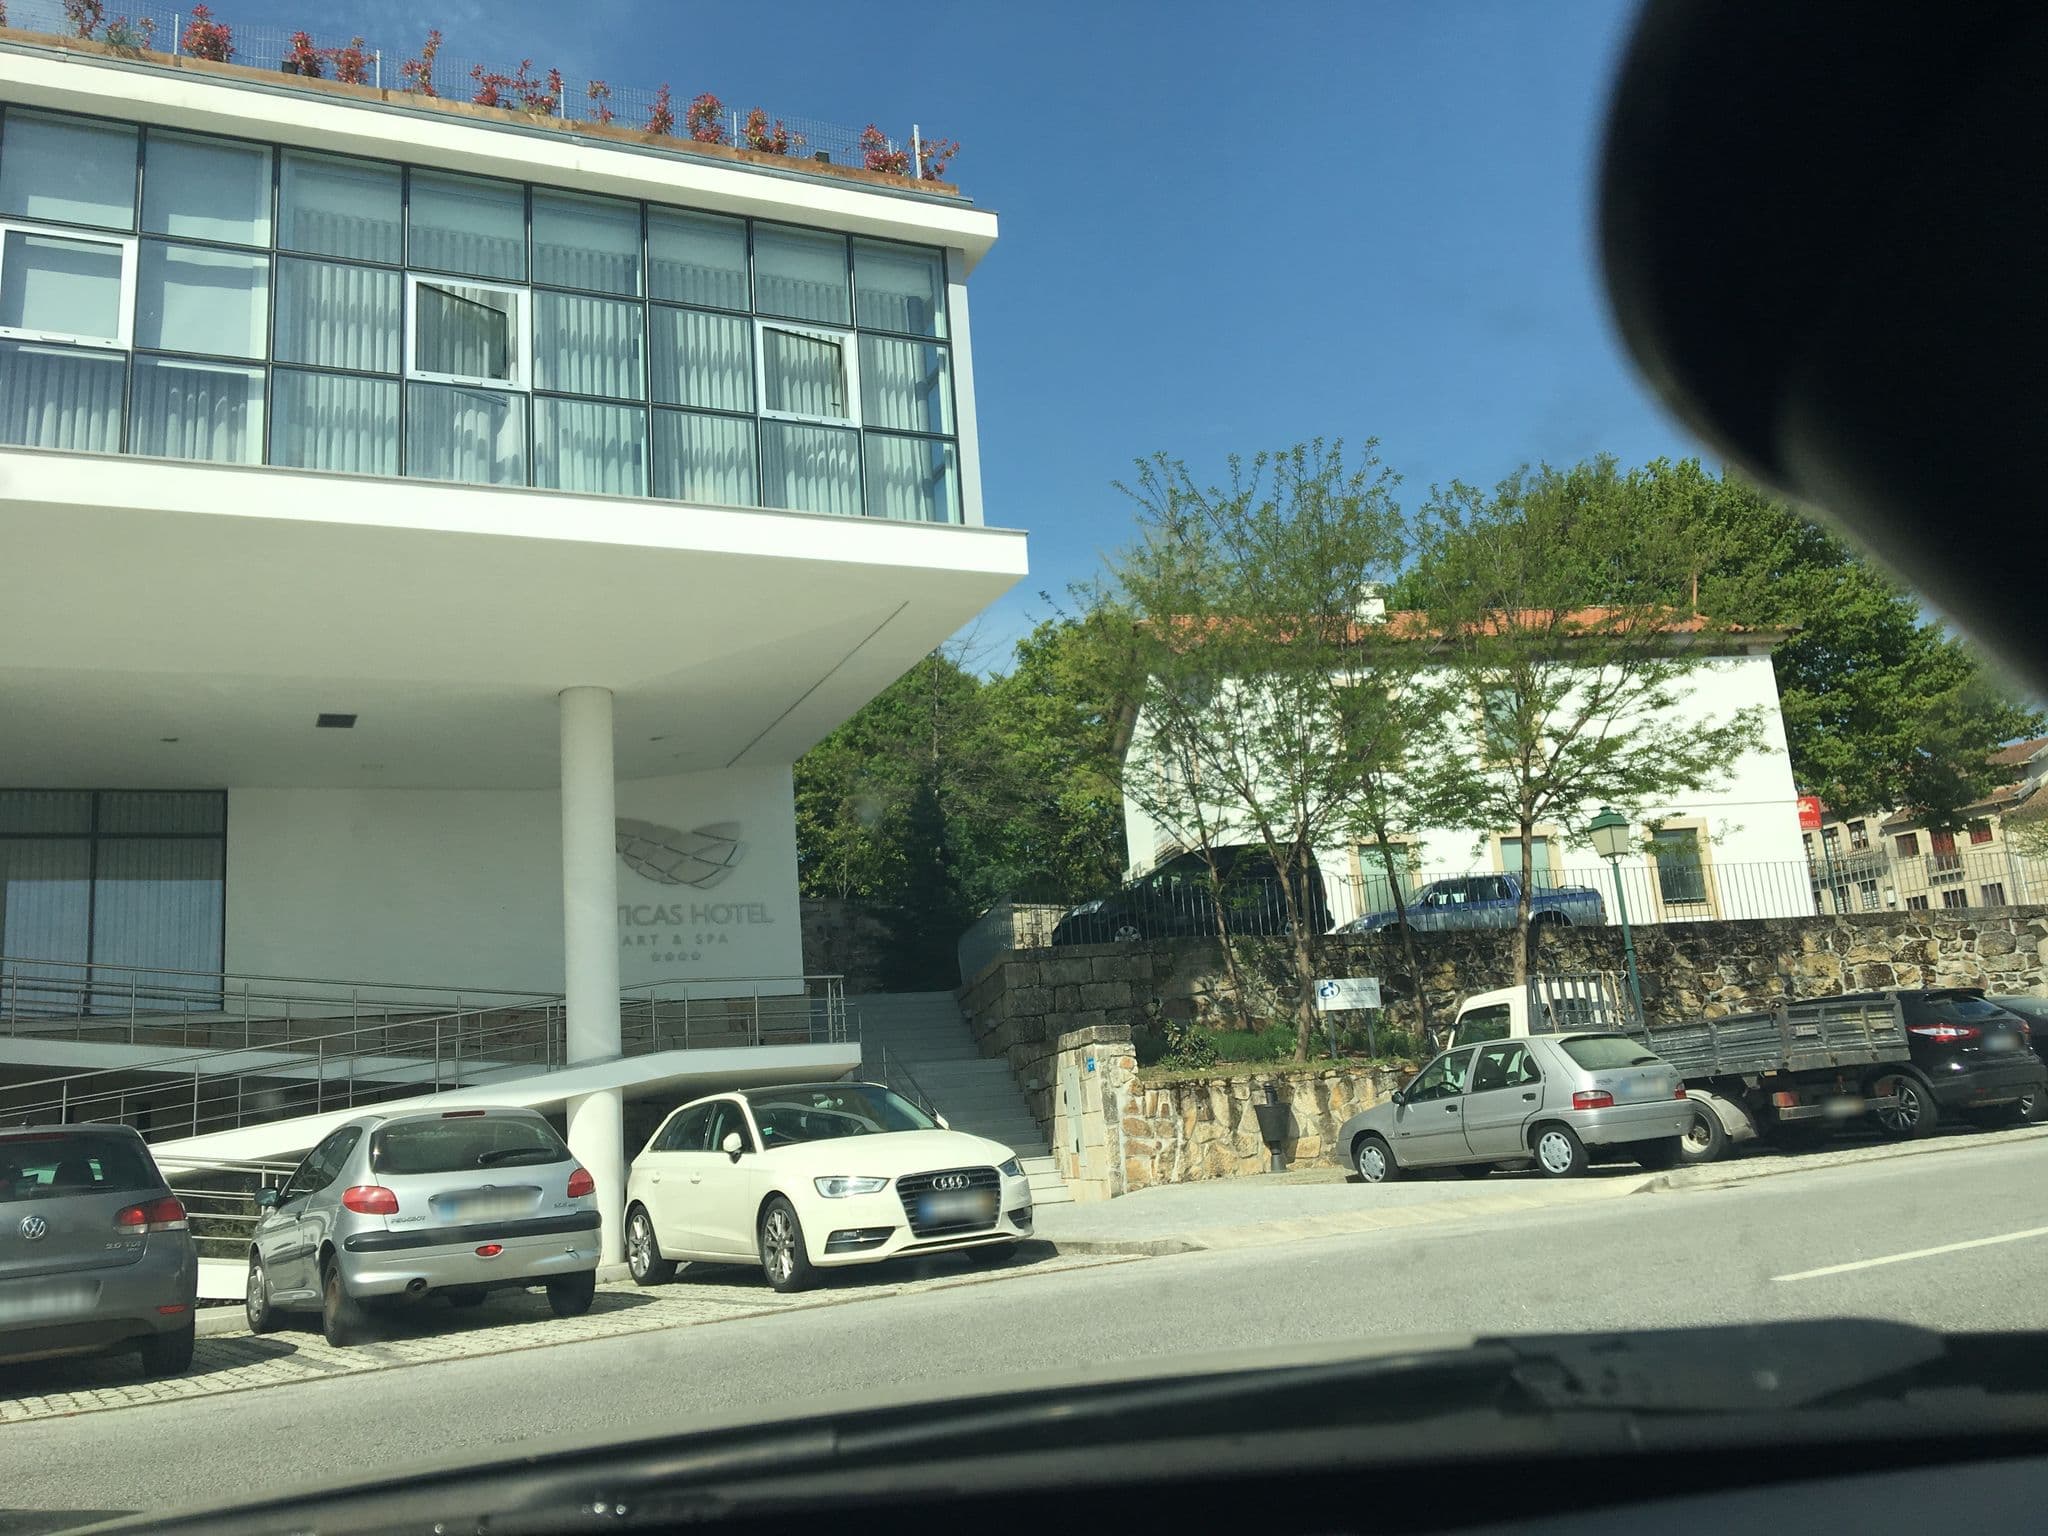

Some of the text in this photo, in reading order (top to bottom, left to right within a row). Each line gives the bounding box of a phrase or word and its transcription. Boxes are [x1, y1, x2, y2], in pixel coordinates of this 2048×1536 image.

[691, 902, 774, 925] HOTEL
[622, 933, 729, 947] ART & SPA
